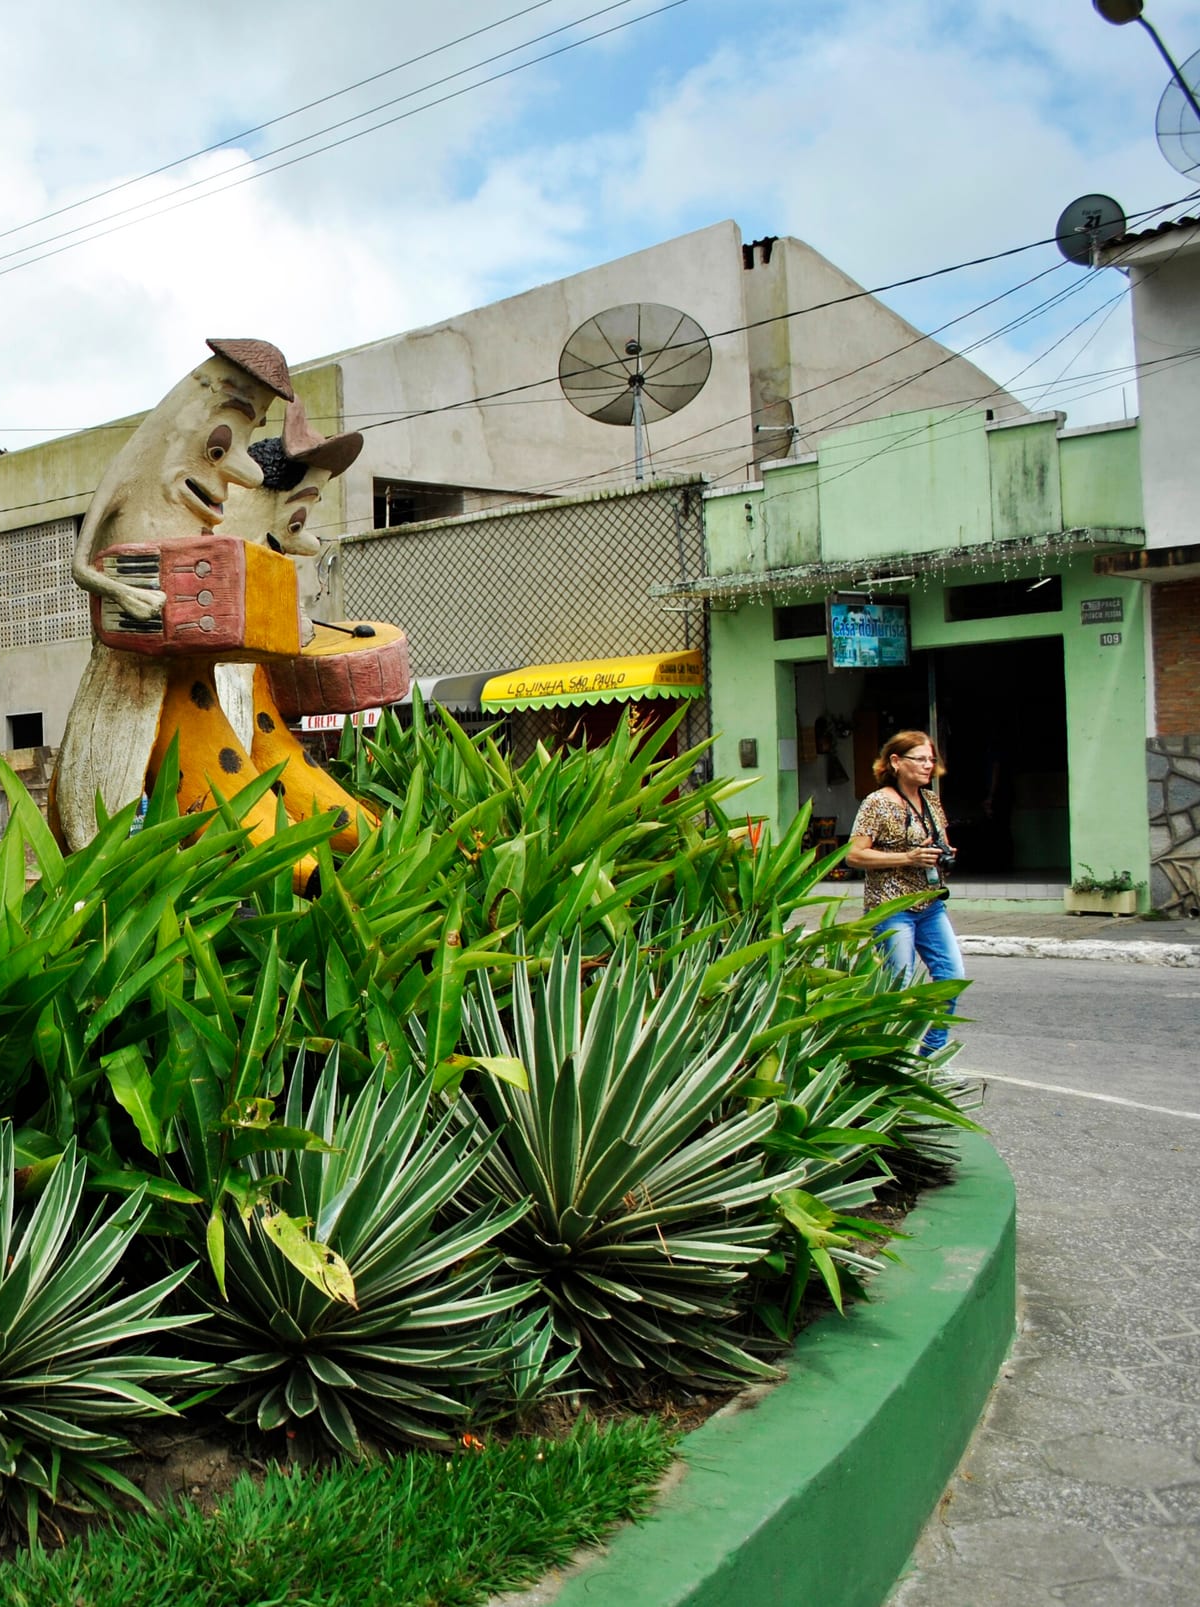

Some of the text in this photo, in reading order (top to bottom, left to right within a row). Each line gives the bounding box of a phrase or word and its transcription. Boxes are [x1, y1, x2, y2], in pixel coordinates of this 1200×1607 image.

[1084, 215, 1101, 228] 21
[832, 616, 905, 637] Casa do Turista
[1103, 634, 1119, 645] 109
[507, 679, 564, 695] LOJINHA
[569, 675, 589, 688] SÃO
[594, 673, 626, 688] PAULO
[307, 714, 337, 729] CREPE
